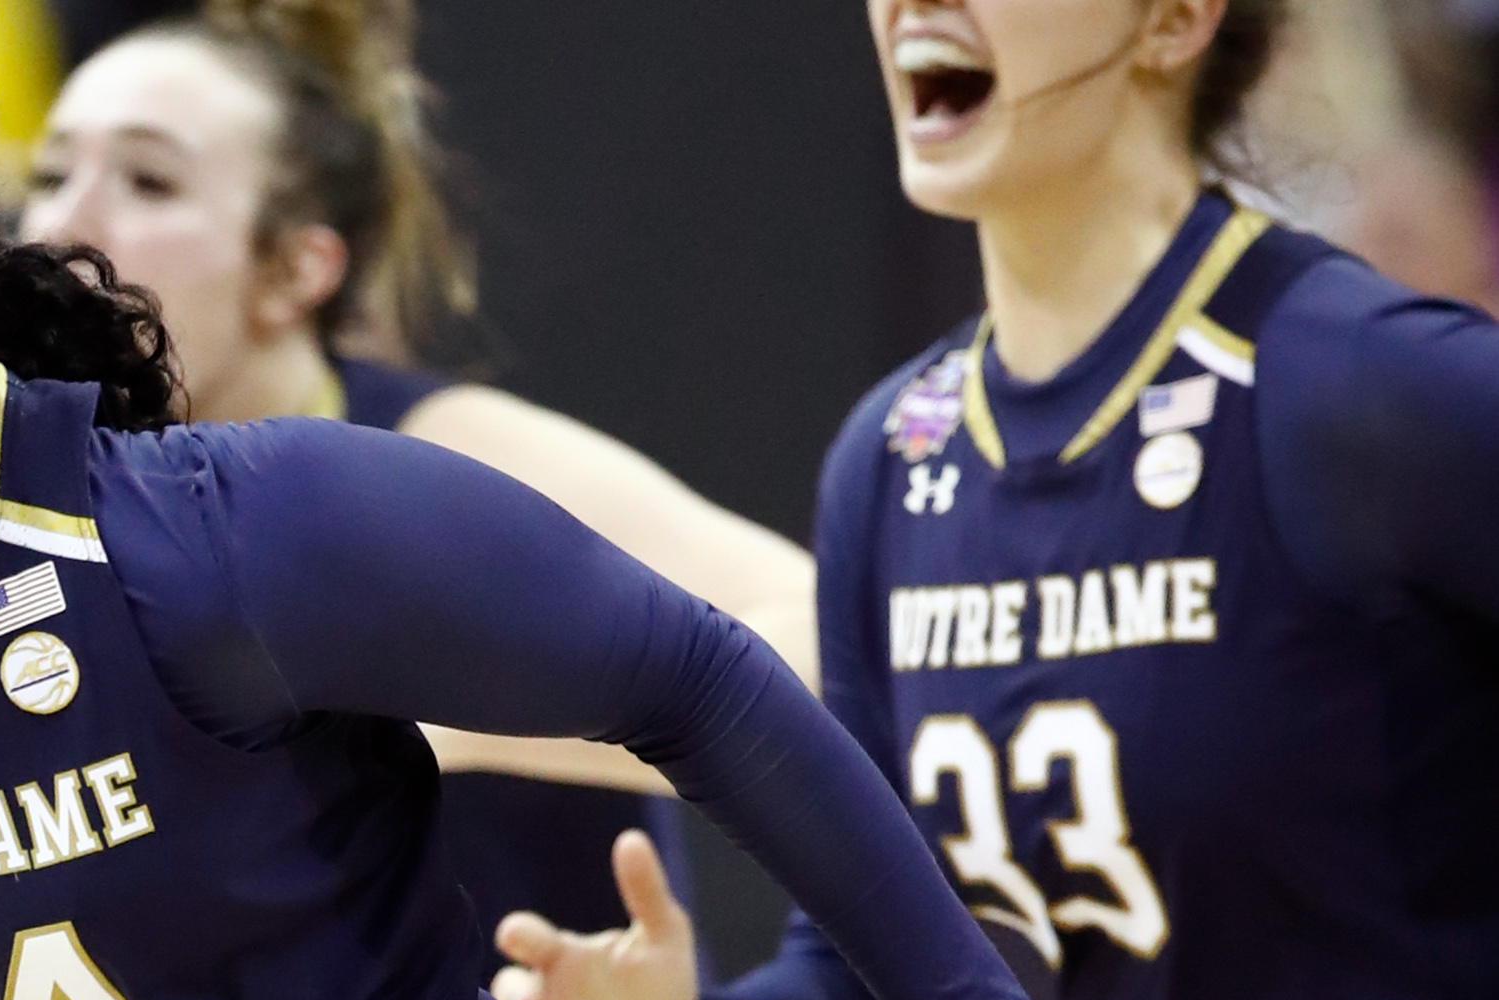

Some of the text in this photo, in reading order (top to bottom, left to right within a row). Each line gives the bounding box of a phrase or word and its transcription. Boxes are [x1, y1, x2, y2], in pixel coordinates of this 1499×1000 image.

[1036, 558, 1217, 661] DAME
[15, 649, 69, 686] ACC
[909, 698, 1171, 970] 33
